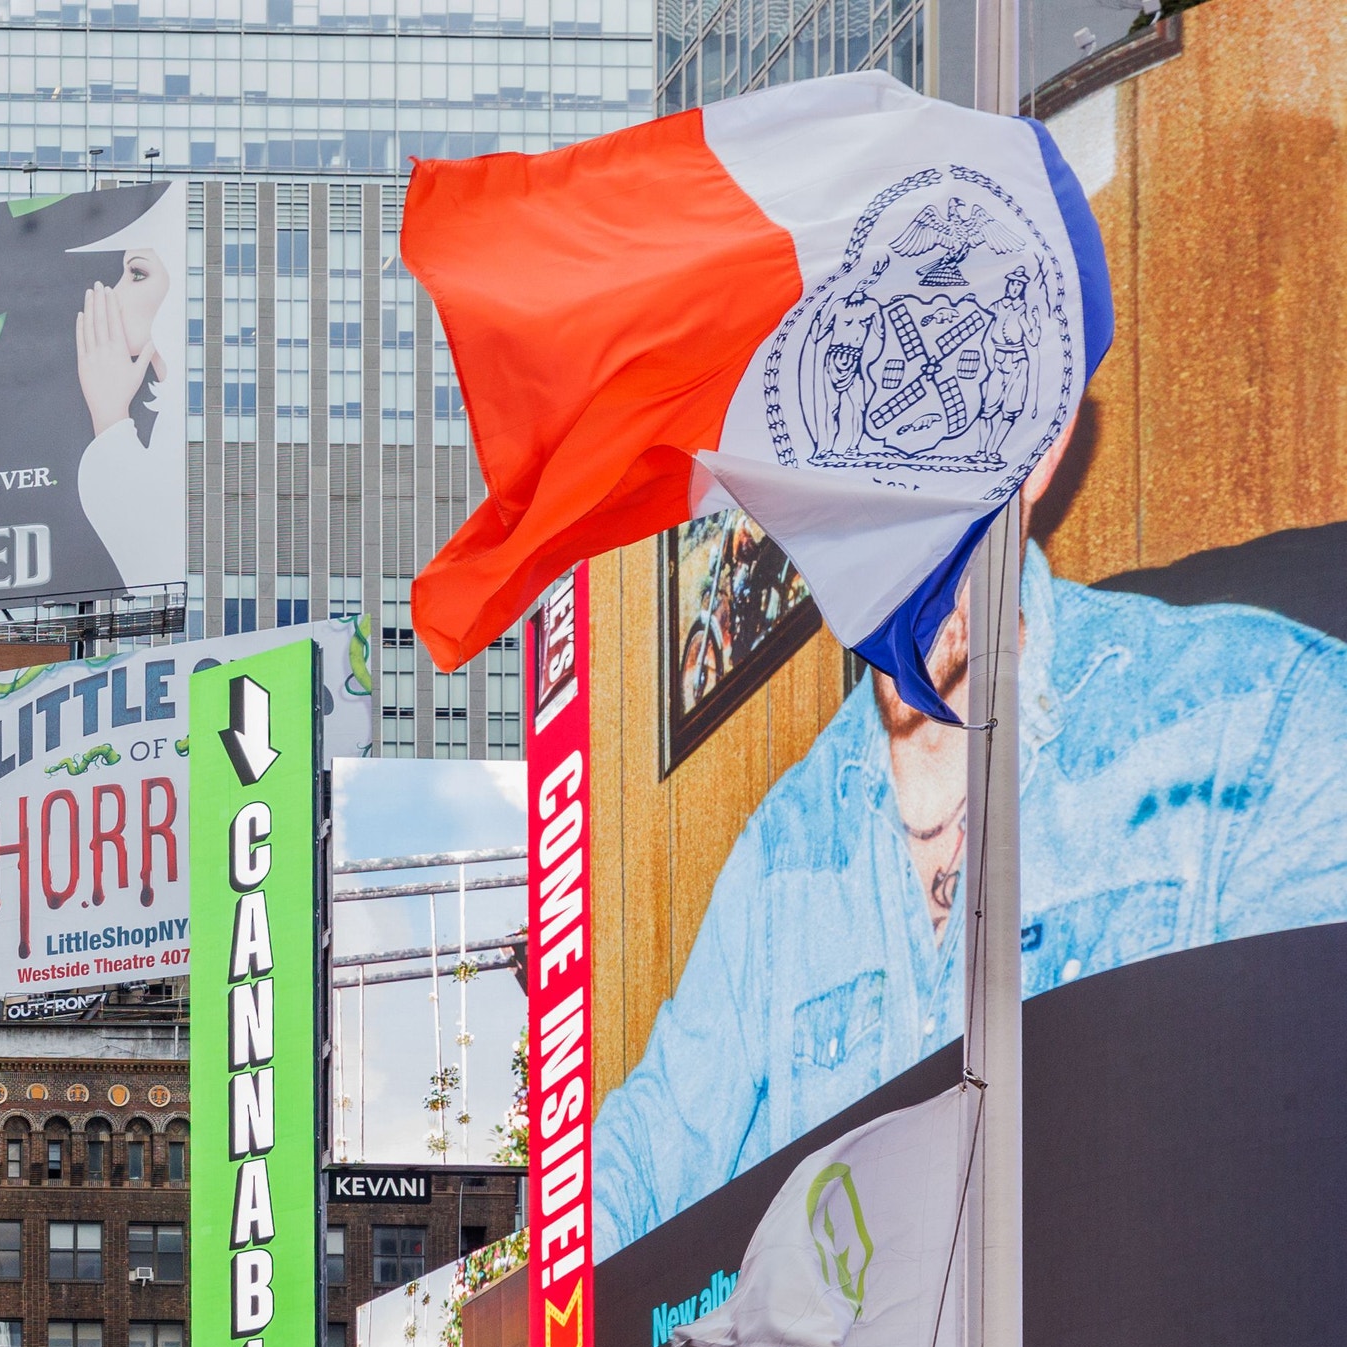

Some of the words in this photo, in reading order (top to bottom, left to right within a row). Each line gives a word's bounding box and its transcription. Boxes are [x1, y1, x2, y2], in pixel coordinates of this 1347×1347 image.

[129, 738, 166, 762] OF
[539, 749, 584, 990] COME
[46, 917, 190, 957] LittleShopNY
[17, 963, 90, 984] Westside
[94, 954, 155, 976] Theatre
[540, 986, 586, 1290] INSIDE!
